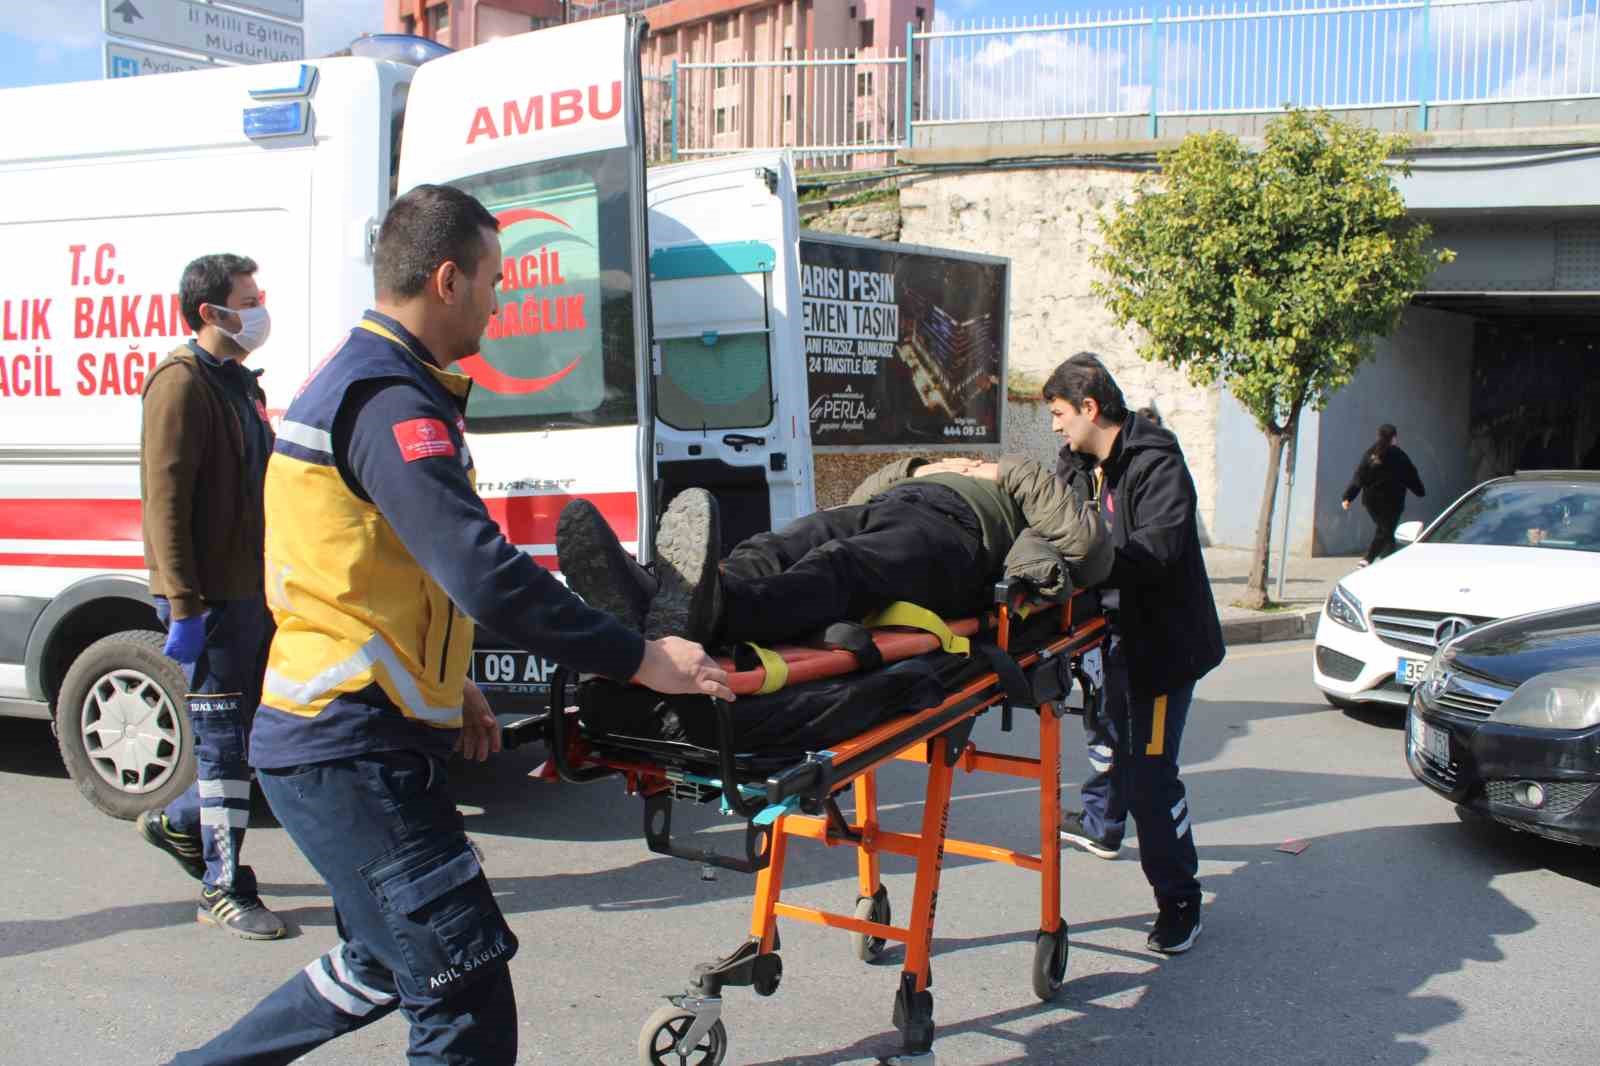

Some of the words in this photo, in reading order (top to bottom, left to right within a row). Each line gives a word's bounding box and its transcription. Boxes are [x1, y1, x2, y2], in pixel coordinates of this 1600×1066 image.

[466, 80, 622, 144] AMBU
[68, 242, 125, 286] T.C.
[502, 245, 566, 293] ACİL
[74, 293, 193, 339] BAKAN
[802, 302, 848, 334] EMEN
[77, 343, 157, 397] SAĞ
[809, 356, 822, 373] 24
[823, 399, 866, 420] PERLA
[484, 654, 516, 682] 09
